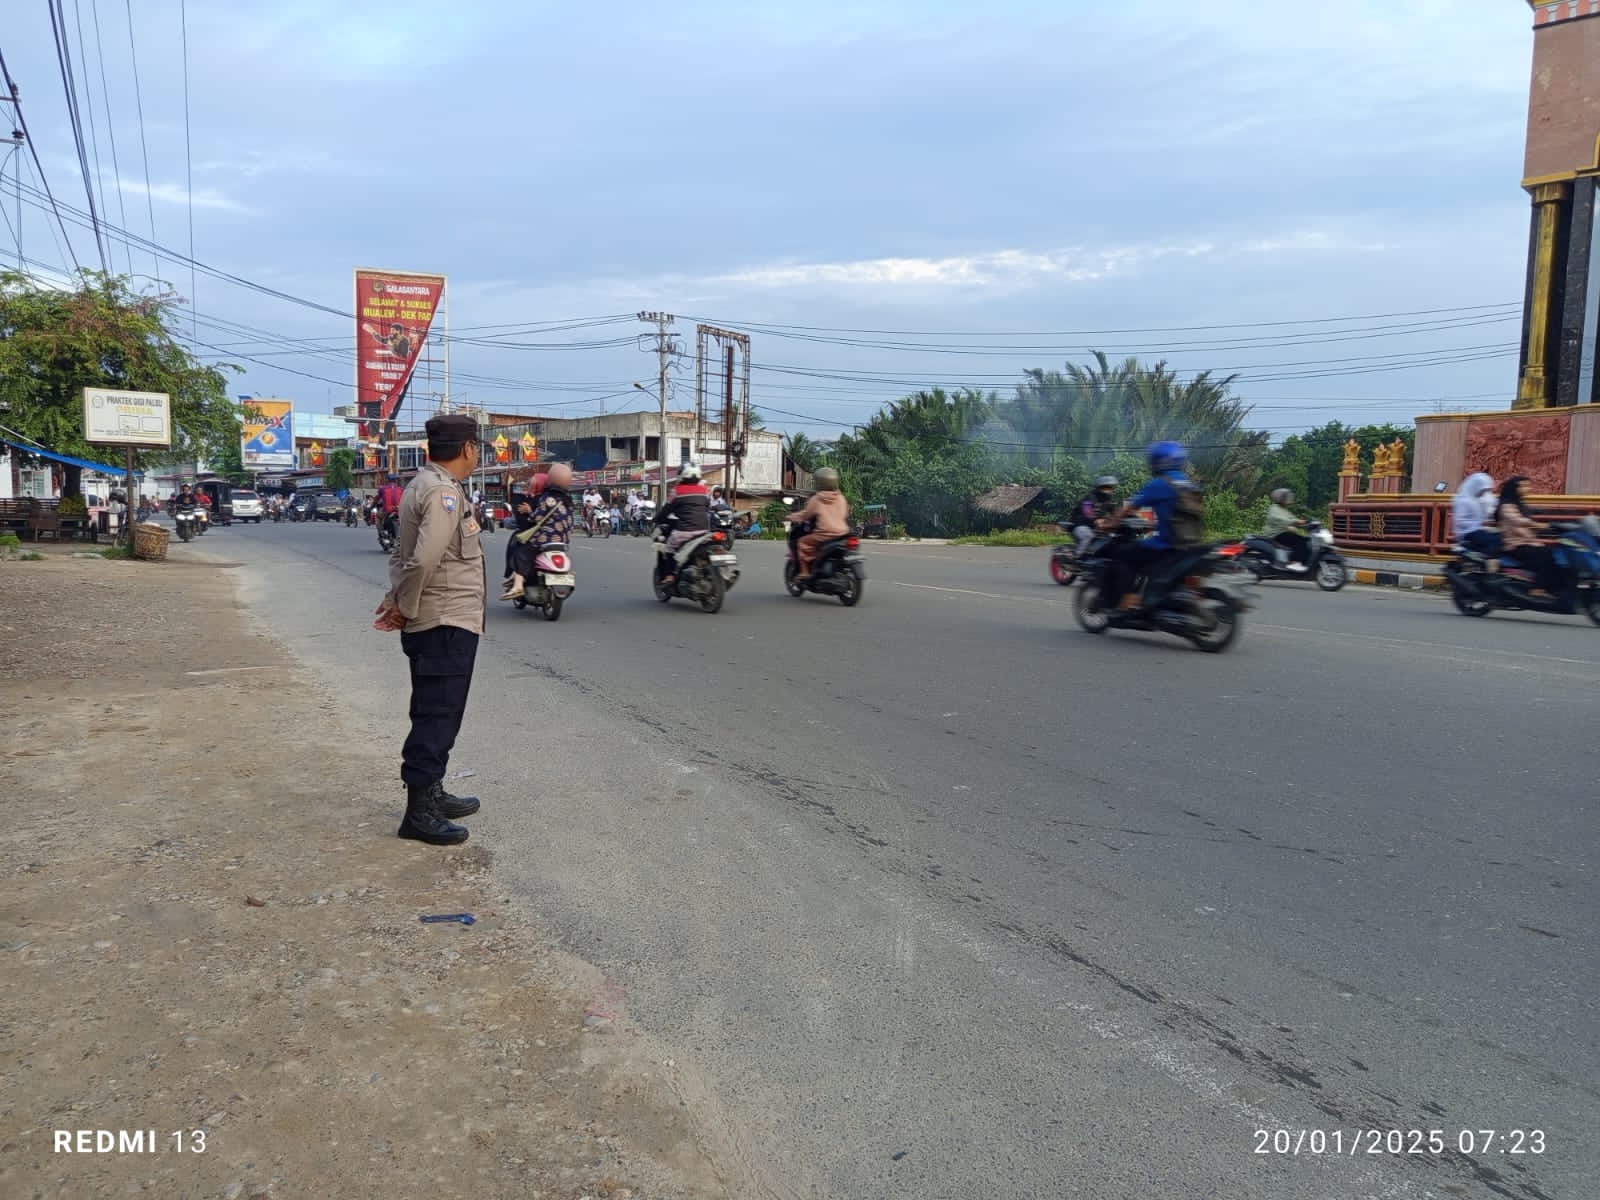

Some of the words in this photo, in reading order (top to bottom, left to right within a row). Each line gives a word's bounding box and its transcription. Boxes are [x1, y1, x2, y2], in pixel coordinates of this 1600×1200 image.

[368, 297, 398, 307] SELAMAT
[406, 300, 432, 309] SUKSES
[363, 308, 395, 318] MUALEM
[401, 310, 417, 319] DEK
[106, 396, 132, 406] PRAKTEK
[133, 397, 144, 406] GIGI
